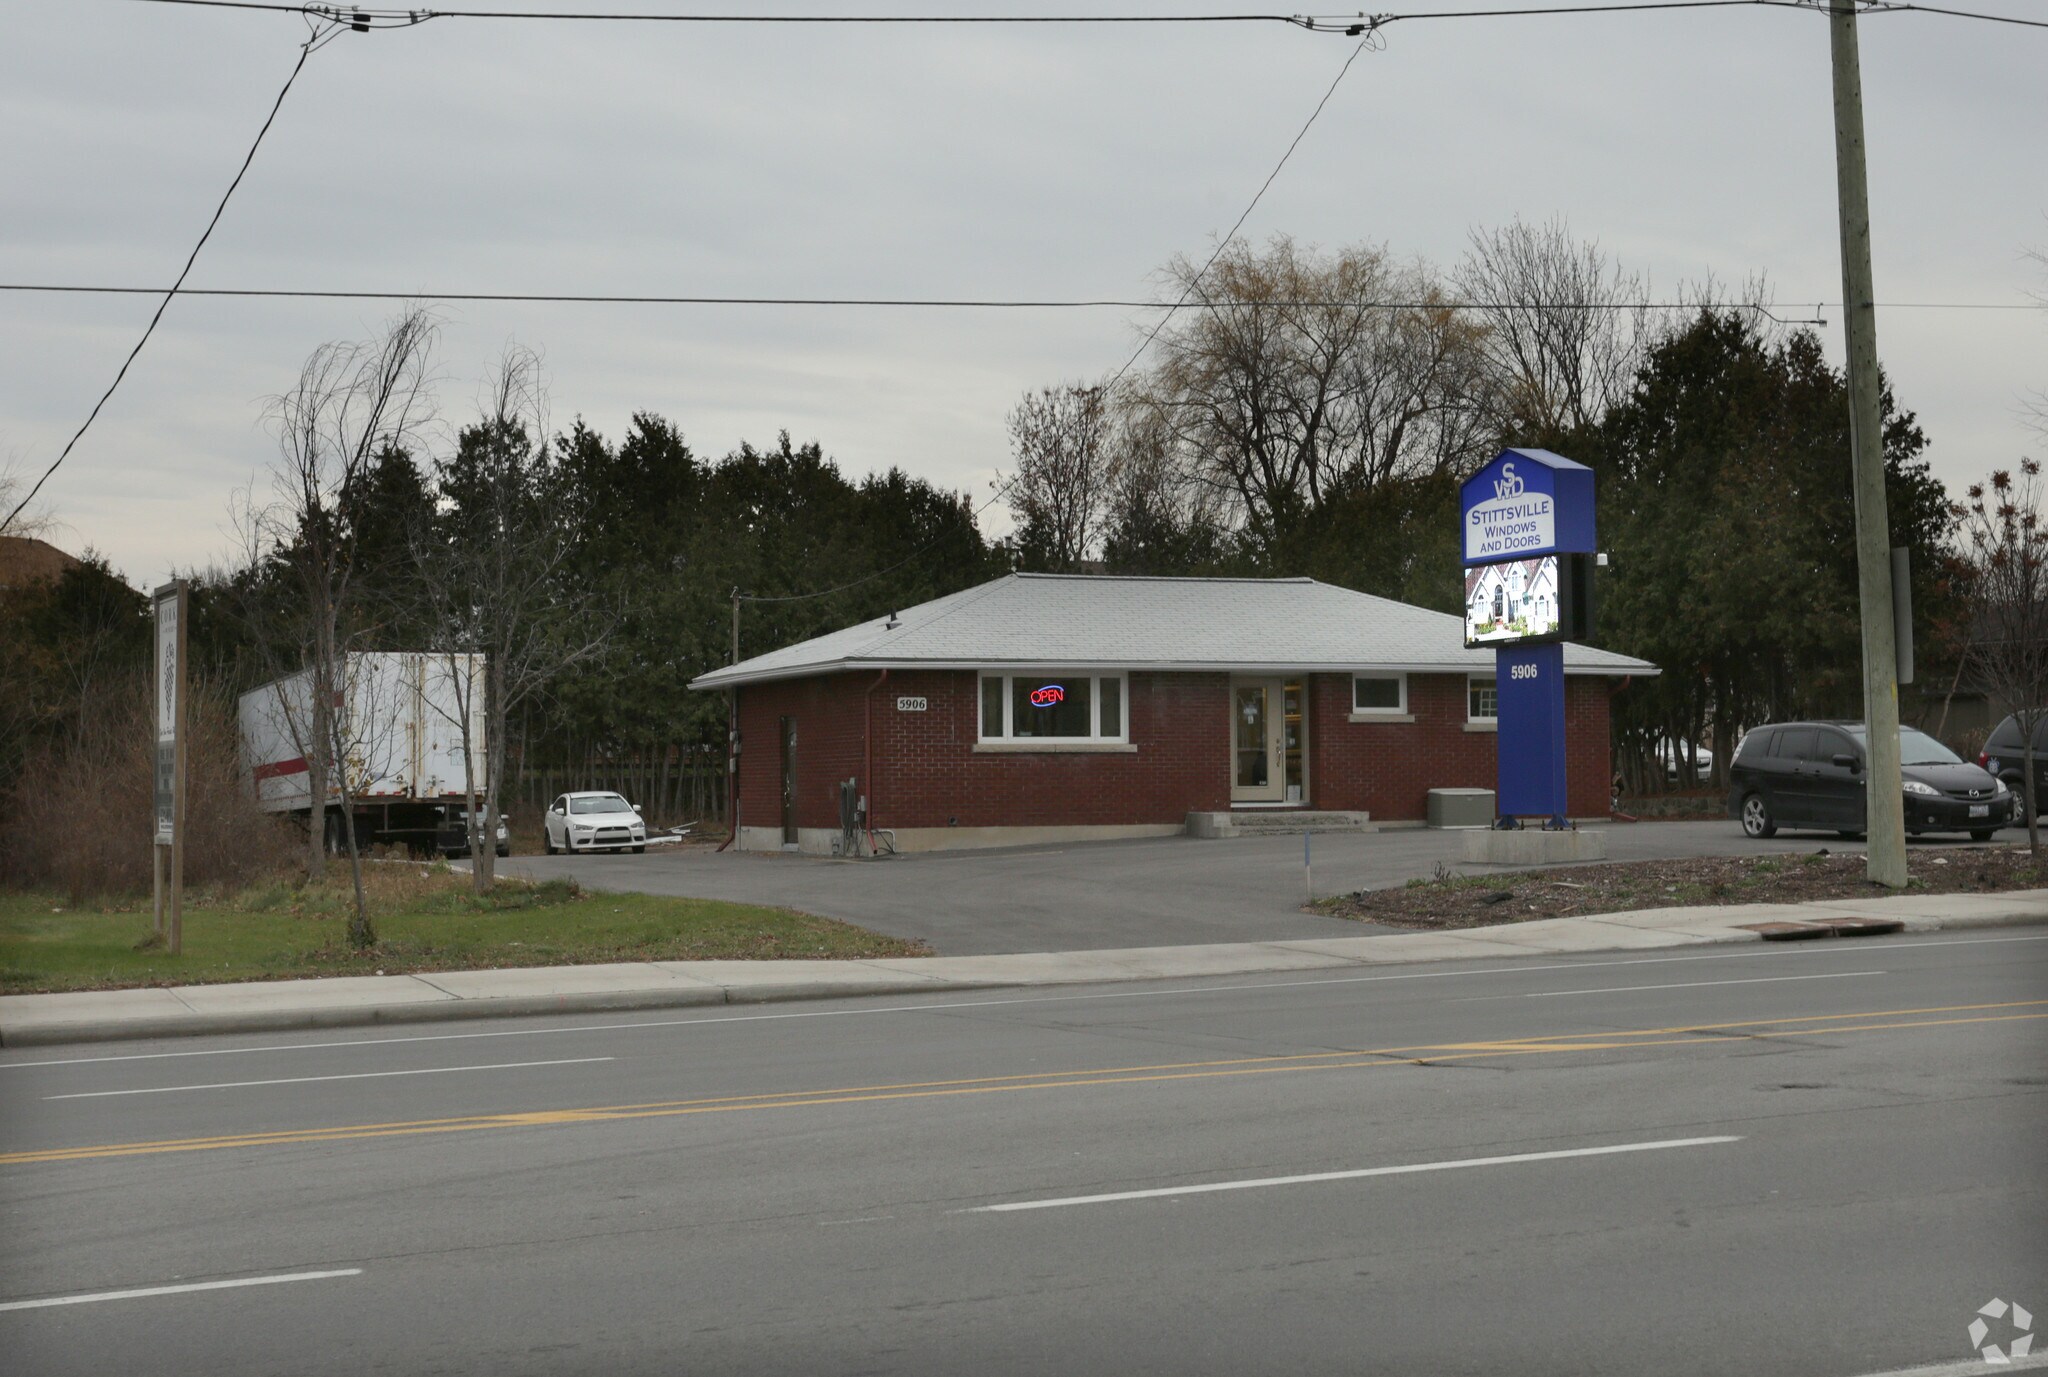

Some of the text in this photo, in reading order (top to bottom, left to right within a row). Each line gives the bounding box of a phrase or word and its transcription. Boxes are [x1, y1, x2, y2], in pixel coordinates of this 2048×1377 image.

[1471, 501, 1549, 525] STITTSVILLE
[1484, 521, 1537, 538] WINDOWS
[1480, 534, 1541, 553] AND DOORS
[1511, 664, 1537, 679] 5906
[1030, 689, 1064, 703] OPEN
[899, 699, 926, 710] 5906
